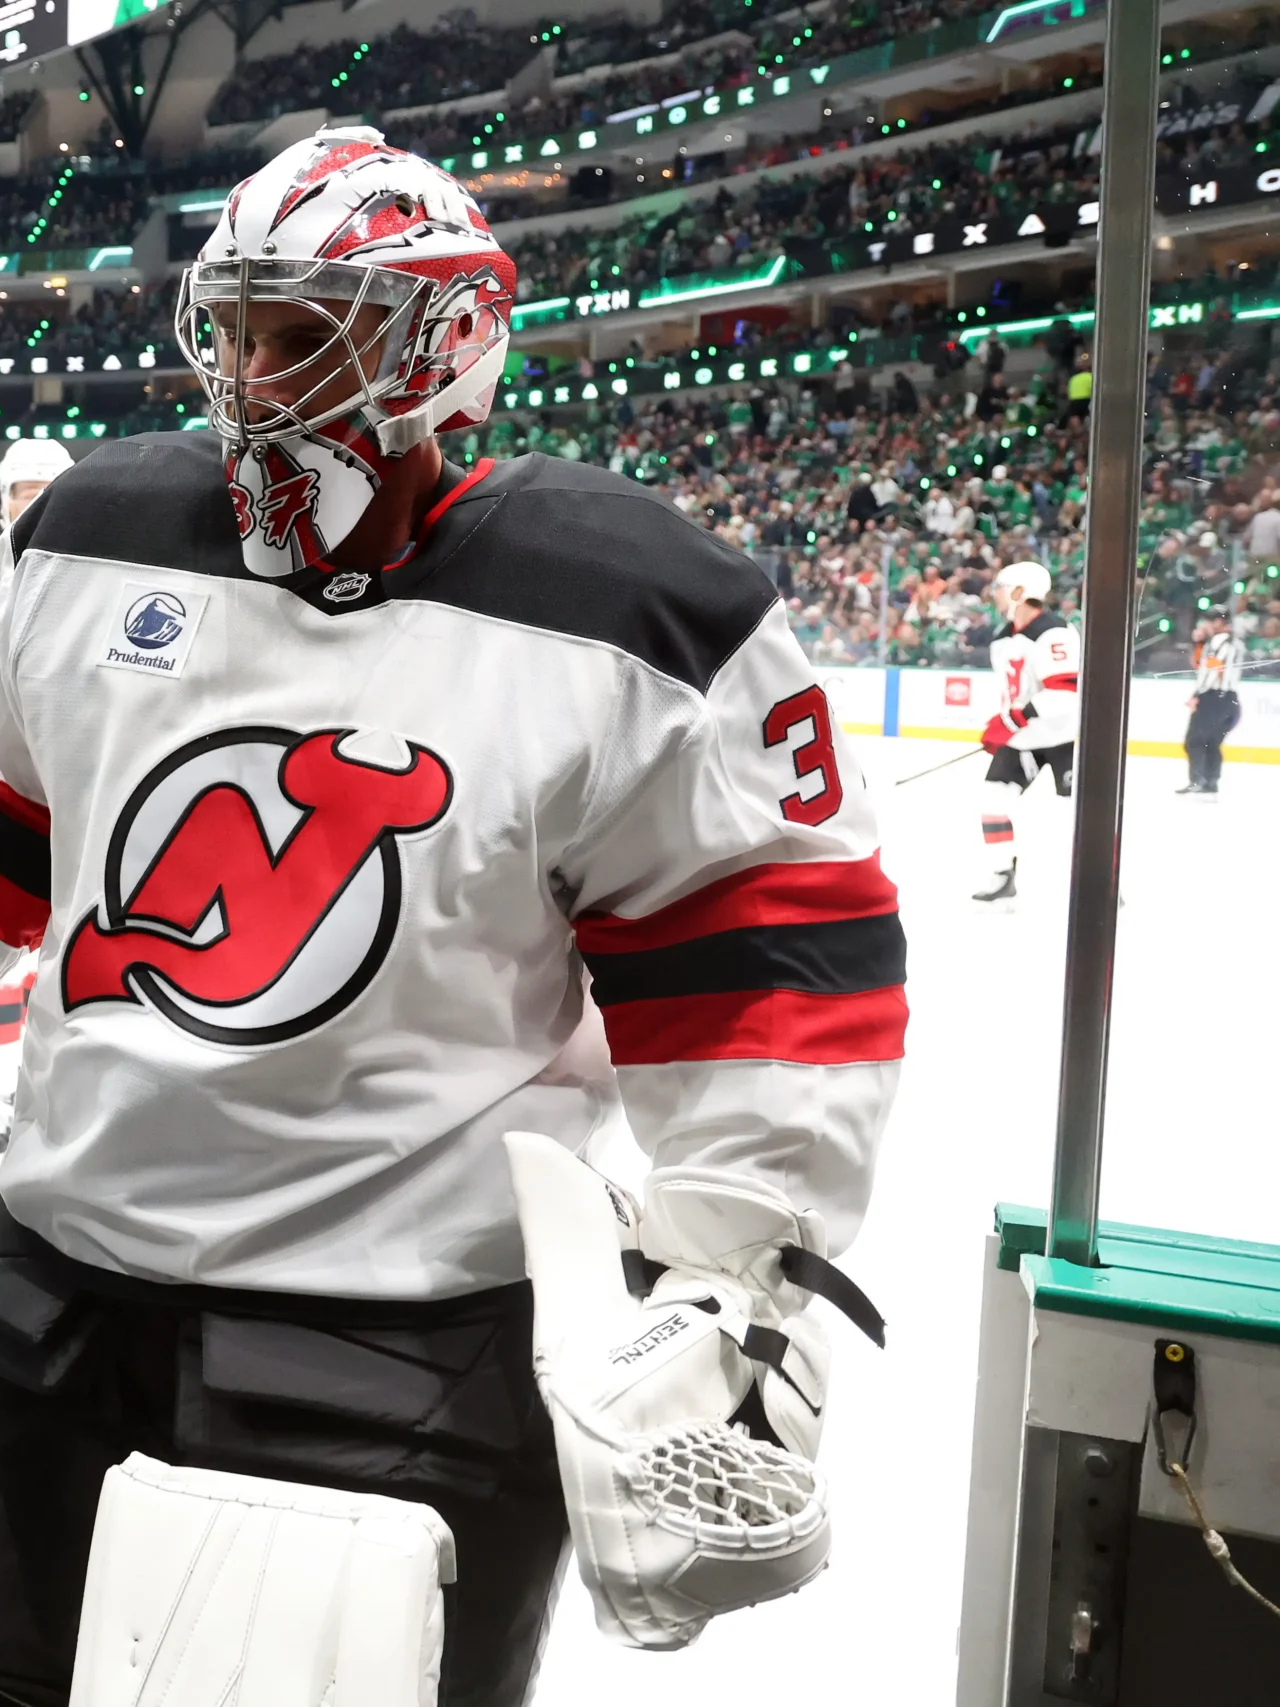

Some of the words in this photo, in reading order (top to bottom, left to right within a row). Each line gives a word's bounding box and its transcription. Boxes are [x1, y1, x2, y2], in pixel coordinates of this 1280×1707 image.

[576, 289, 630, 316] TXH
[1150, 302, 1203, 328] XH
[331, 578, 362, 595] NHL
[106, 648, 177, 671] Prudential
[1050, 643, 1067, 661] 5
